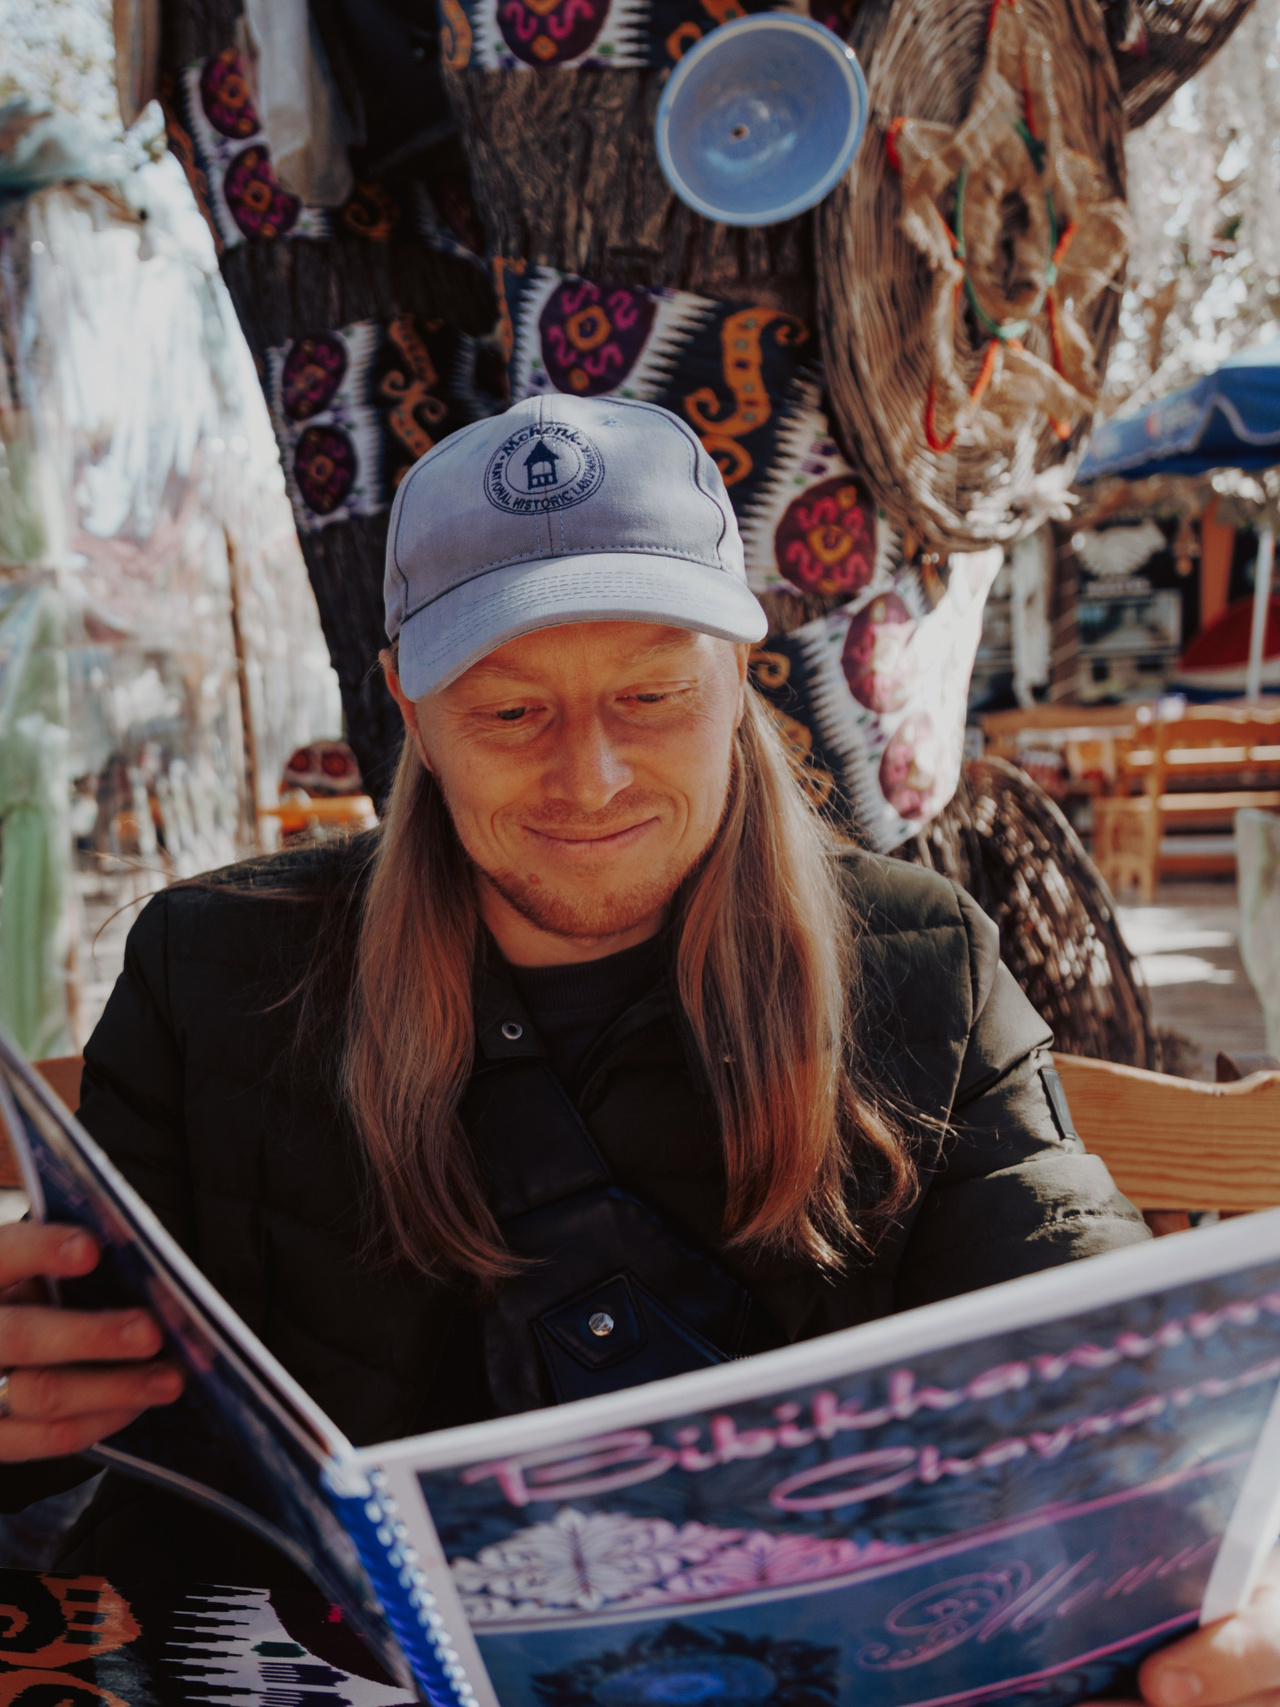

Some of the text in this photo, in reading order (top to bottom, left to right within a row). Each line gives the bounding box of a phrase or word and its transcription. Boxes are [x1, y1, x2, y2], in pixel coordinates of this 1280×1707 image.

[502, 426, 581, 457] Mohonk
[491, 462, 513, 506] NATIONAL
[513, 490, 573, 511] HISTORIC
